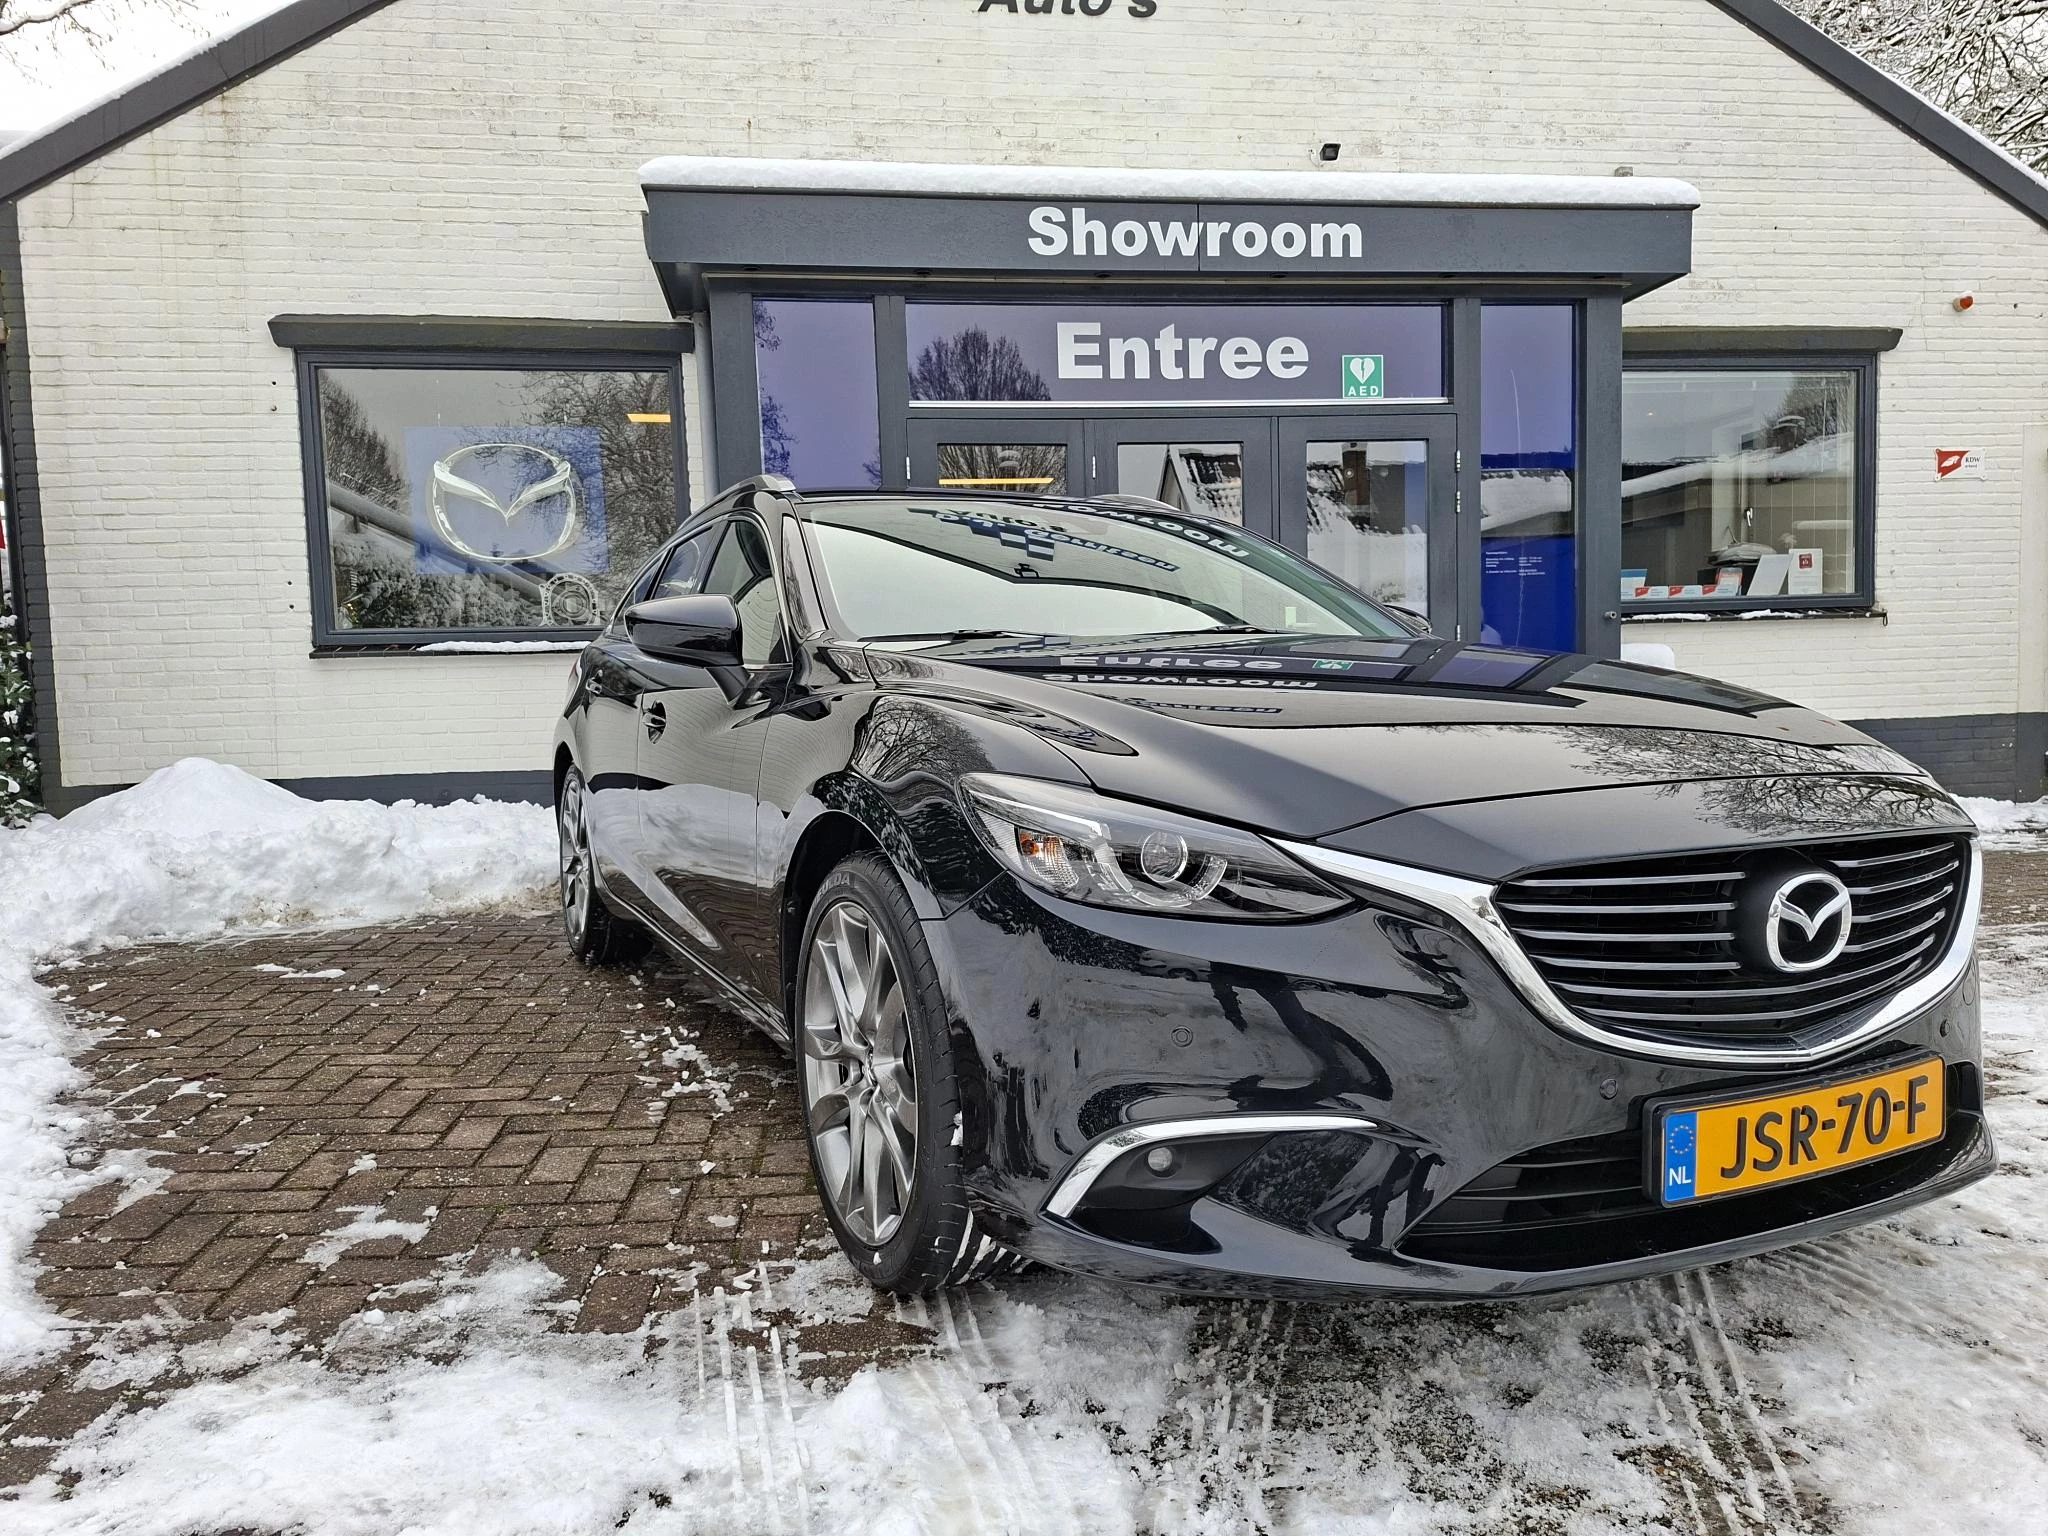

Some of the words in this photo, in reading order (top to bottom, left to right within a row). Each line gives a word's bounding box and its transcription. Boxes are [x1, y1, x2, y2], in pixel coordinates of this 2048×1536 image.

[978, 0, 1157, 18] uos
[1028, 206, 1363, 258] Showroom
[1057, 322, 1309, 380] Entree
[1348, 385, 1379, 396] AED
[1720, 1075, 1929, 1179] JSR-70-F
[1669, 1166, 1692, 1187] NL
